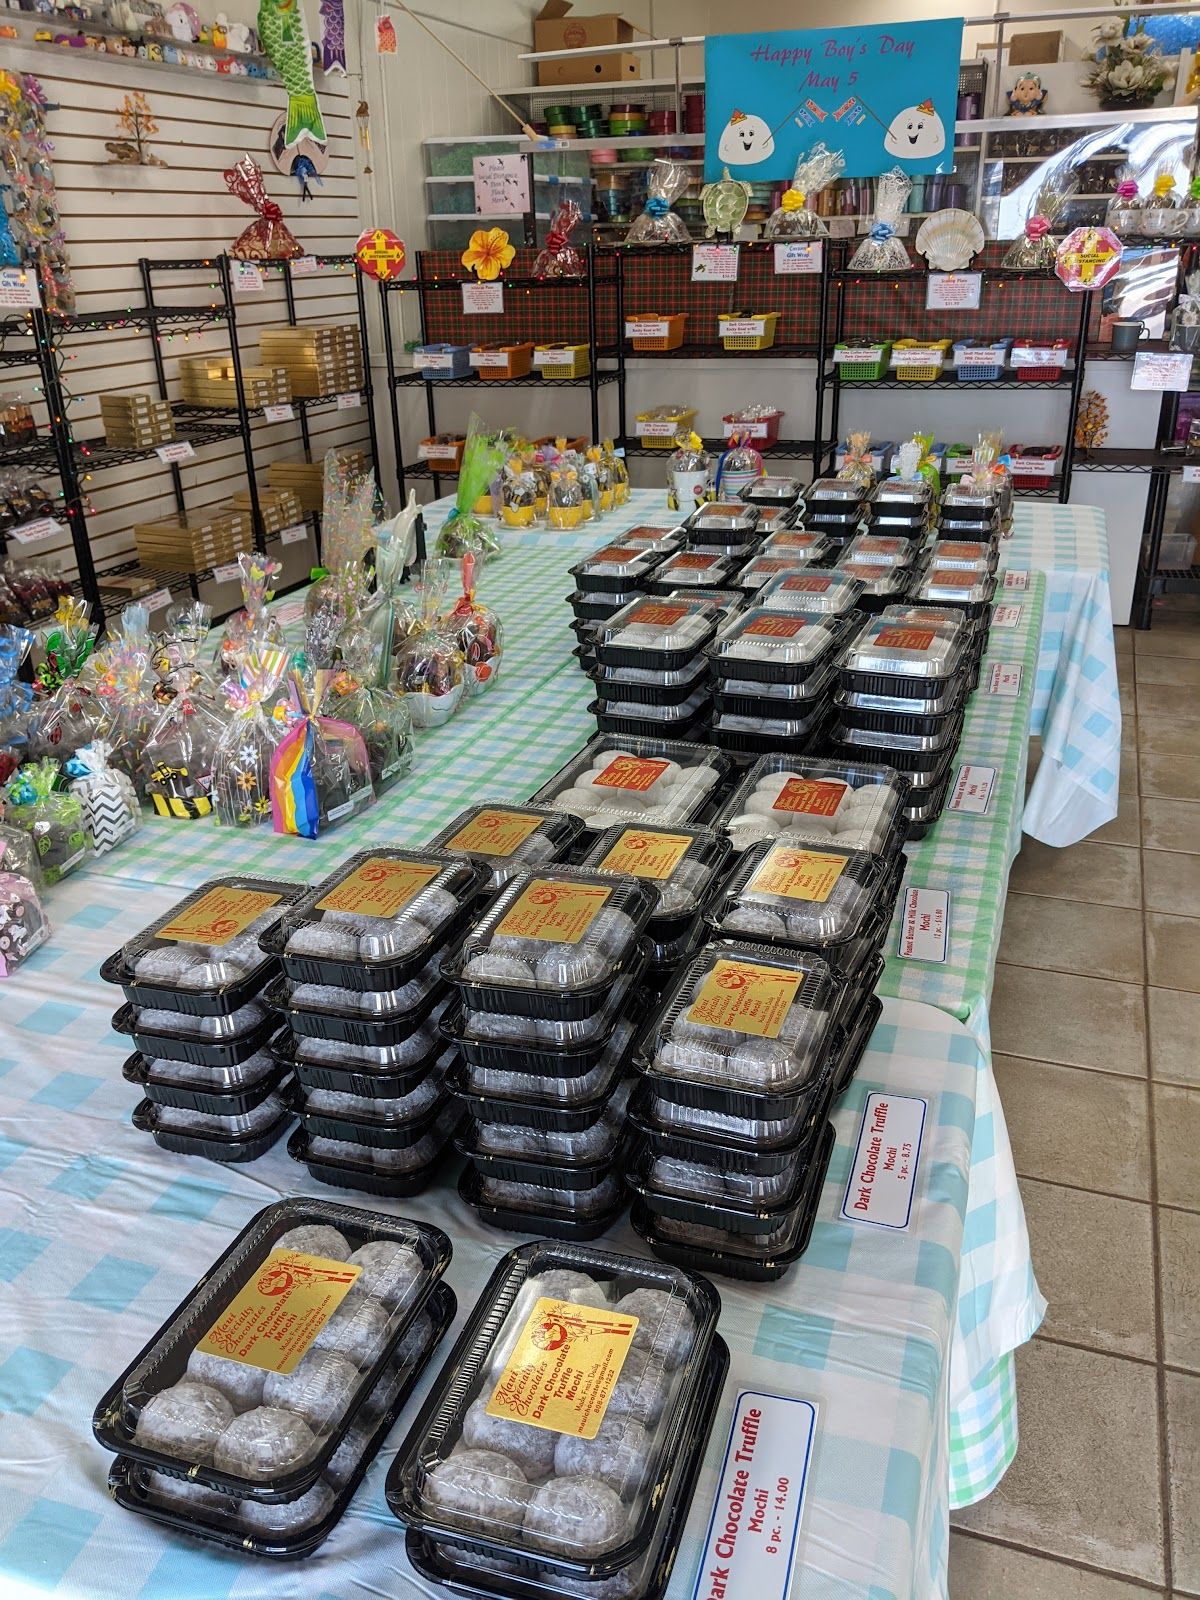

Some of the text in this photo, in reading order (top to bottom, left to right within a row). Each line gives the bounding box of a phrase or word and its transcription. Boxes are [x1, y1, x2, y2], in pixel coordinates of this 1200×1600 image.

[751, 35, 916, 67] Happy Boy's Day
[798, 70, 859, 92] May 5
[966, 783, 978, 796] Mochi
[907, 908, 916, 919] Milk
[908, 888, 919, 908] Chocolate
[529, 900, 559, 935] Dark Chocolate
[905, 924, 915, 940] Butter
[918, 913, 931, 931] Mochi
[903, 940, 913, 956] Peanut
[692, 998, 708, 1017] Maui
[723, 985, 749, 1025] Dark Chocolate
[739, 998, 753, 1014] Truffle
[749, 1000, 762, 1017] Mochi
[854, 1102, 888, 1211] Dark Chocolate Truffle
[883, 1147, 898, 1171] Mochi
[902, 1143, 912, 1158] 8.75
[900, 1165, 909, 1177] pc.
[208, 1312, 235, 1343] Maui
[217, 1307, 253, 1349] Specialty
[224, 1306, 265, 1353] Chocolates
[238, 1289, 291, 1356] Dark Chocolate
[263, 1311, 287, 1337] Truffle
[274, 1313, 297, 1341] Mochi
[495, 1369, 518, 1405] Maui
[505, 1363, 535, 1411] Specialty
[515, 1361, 548, 1415] Chocolates
[532, 1343, 571, 1419] Dark Chocolate
[553, 1367, 573, 1397] Truffle
[565, 1369, 584, 1400] Mochi
[574, 1362, 600, 1411] Made Fresh Daily
[577, 1348, 613, 1432] mauichocolate@gmail.com
[594, 1368, 614, 1412] 808-871-1222
[705, 1408, 762, 1600] ark Chocolate Truffle
[774, 1477, 790, 1511] 14.00
[747, 1488, 769, 1533] Mochi
[765, 1545, 777, 1554] 8
[770, 1526, 782, 1543] pc.
